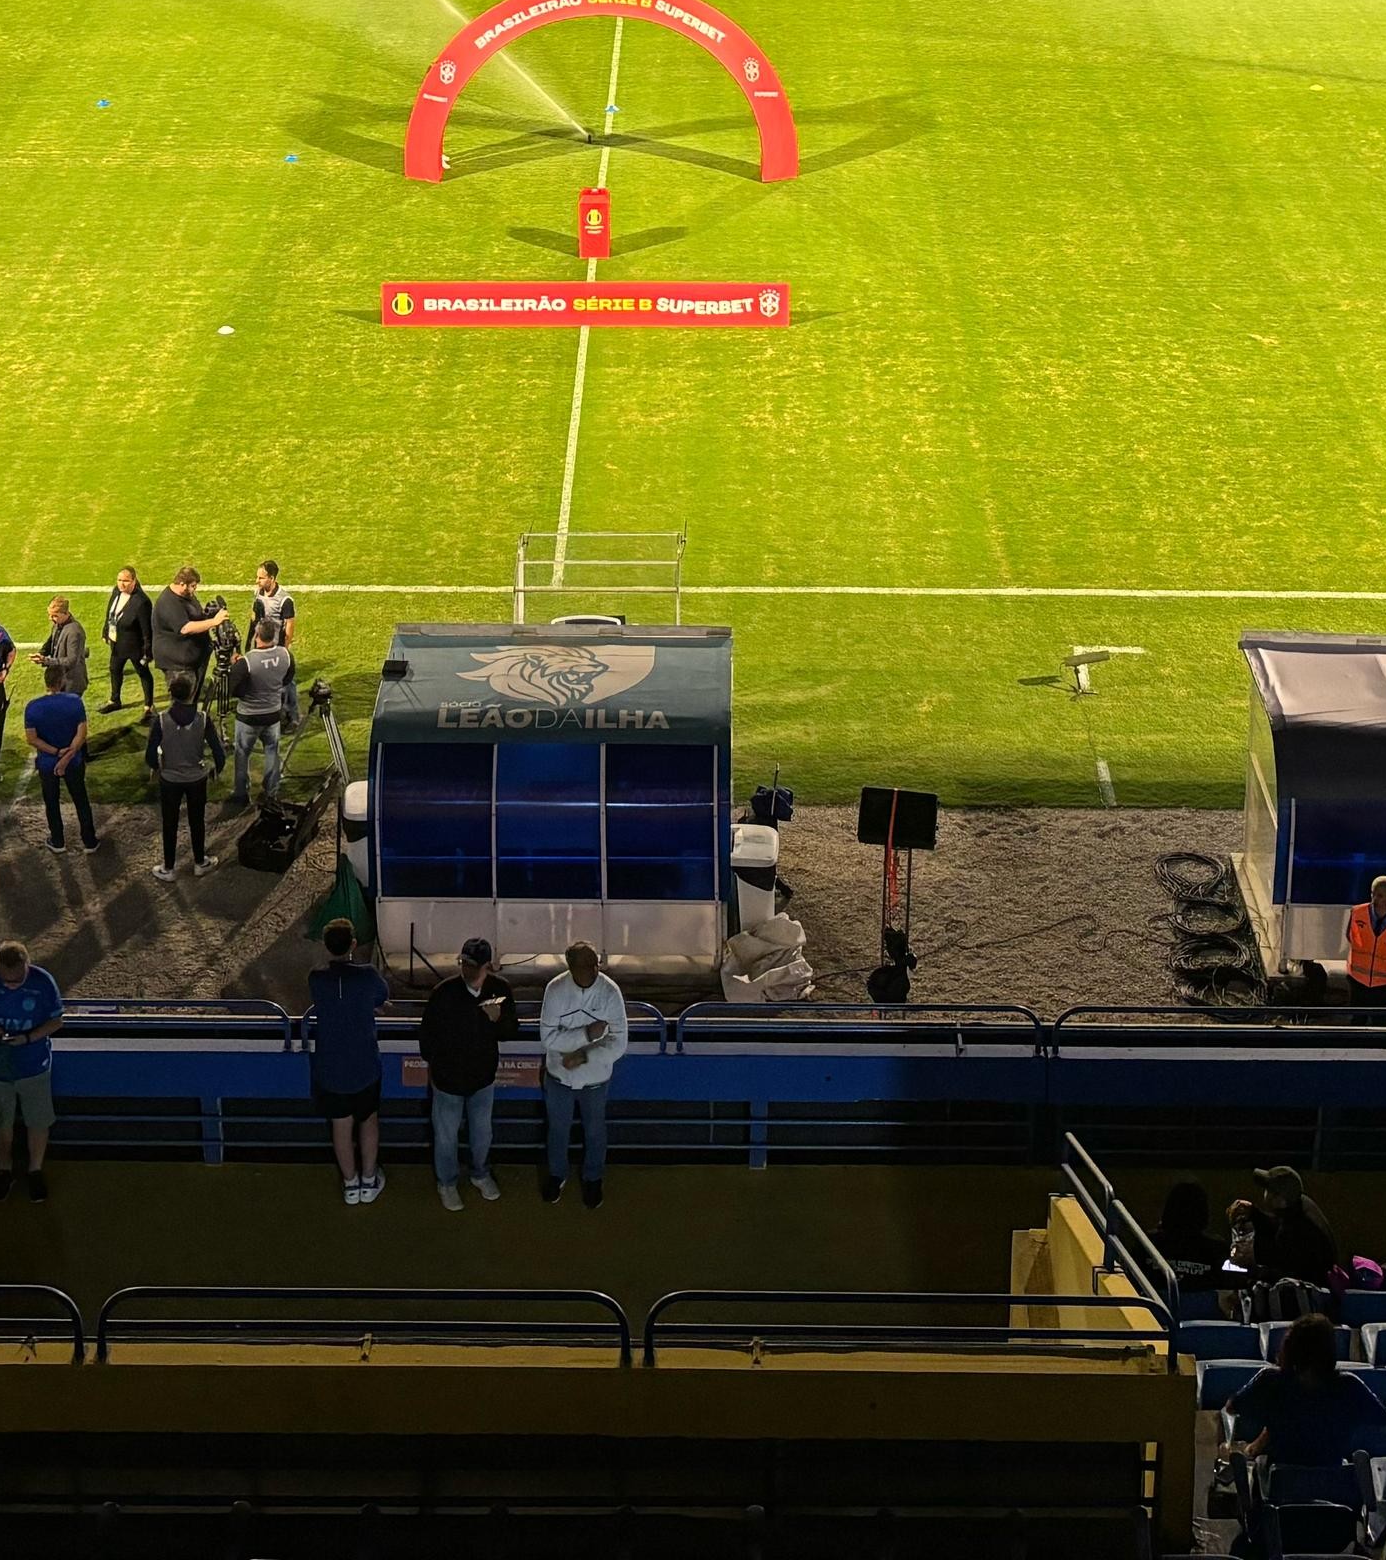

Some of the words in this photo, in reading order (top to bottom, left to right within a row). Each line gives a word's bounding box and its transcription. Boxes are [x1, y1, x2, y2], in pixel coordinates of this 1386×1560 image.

[654, 0, 727, 44] SUPERBET
[423, 295, 567, 312] BRASILEIRÃO
[573, 294, 634, 311] SÉRIE
[639, 298, 653, 311] B
[655, 296, 754, 316] SUPERBET
[260, 656, 280, 670] TV
